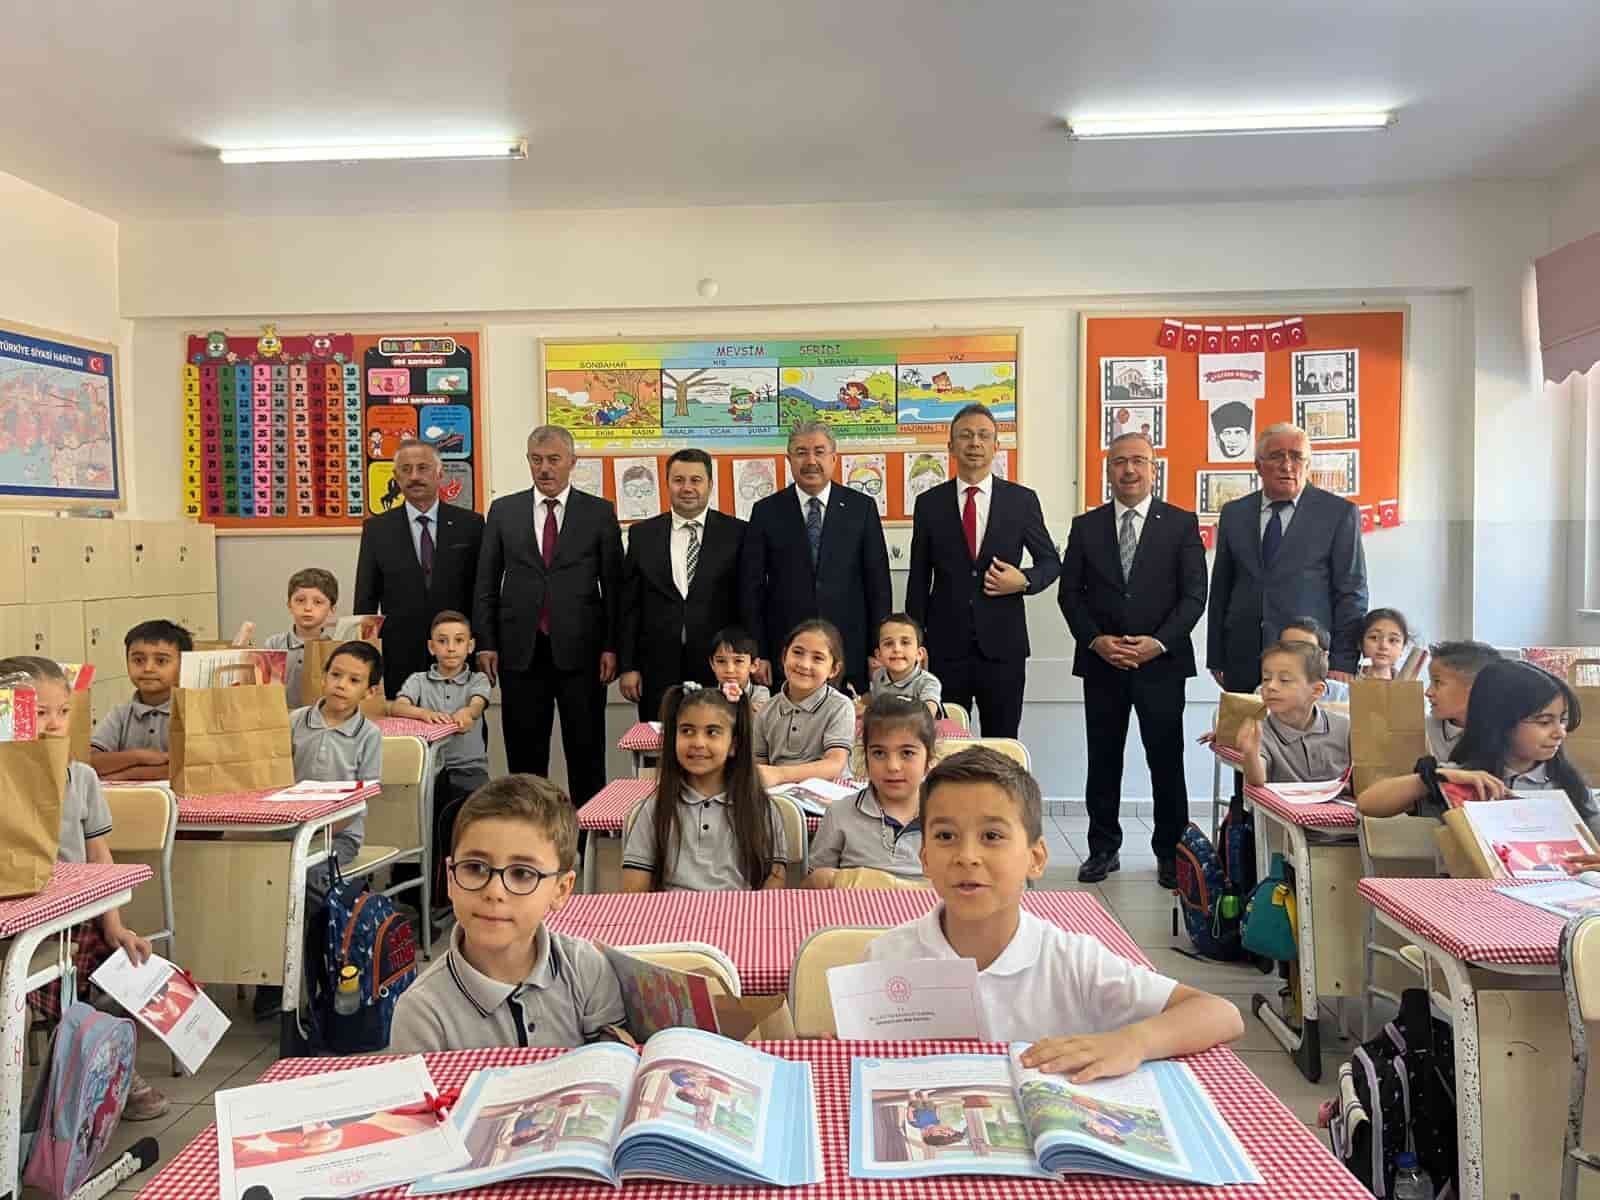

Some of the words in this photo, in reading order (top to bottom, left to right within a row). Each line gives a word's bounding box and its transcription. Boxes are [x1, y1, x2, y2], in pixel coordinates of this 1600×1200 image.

[187, 367, 192, 377] 1
[259, 367, 264, 377] 5
[277, 367, 282, 377] 6
[296, 367, 301, 377] 7
[346, 367, 355, 377] 10
[187, 383, 193, 392] 2
[258, 383, 267, 392] 10
[275, 383, 284, 392] 12
[347, 383, 356, 392] 20
[187, 398, 193, 408] 3
[347, 398, 357, 408] 30
[187, 413, 194, 423] 4
[188, 429, 194, 438] 5
[188, 444, 195, 453] 6
[187, 459, 194, 469] 7
[188, 475, 195, 484] 8
[188, 490, 195, 499] 9
[186, 503, 197, 514] 10
[258, 505, 268, 514] 50
[349, 505, 362, 514] 100
